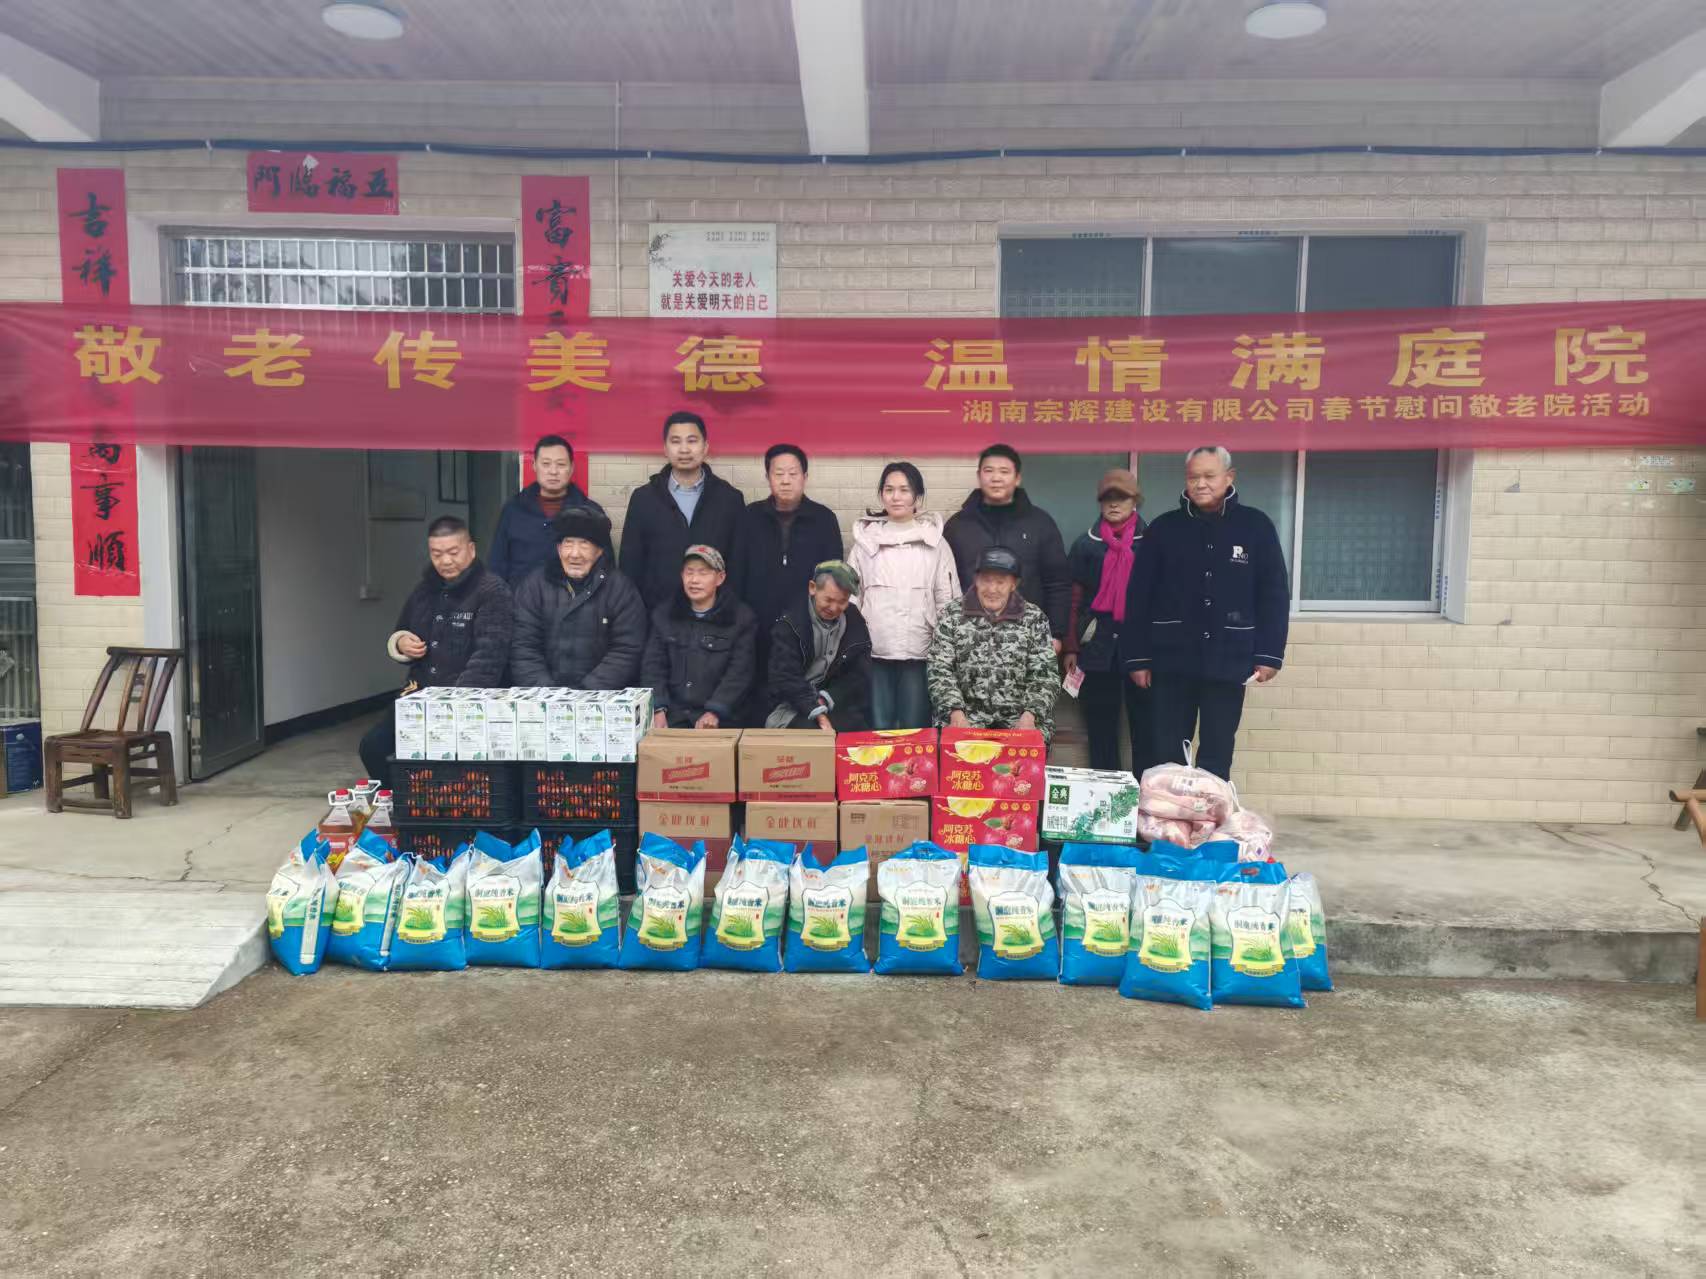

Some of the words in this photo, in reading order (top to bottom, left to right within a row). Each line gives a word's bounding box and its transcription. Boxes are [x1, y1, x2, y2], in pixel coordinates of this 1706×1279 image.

[672, 270, 756, 288] 关爱今天的老人
[661, 292, 768, 311] 就是关爱明天的自己
[73, 324, 766, 392] 敬老传美德
[924, 324, 1649, 392] 温情满庭院
[844, 771, 879, 784] 阿克苏
[946, 769, 982, 783] 阿克苏
[849, 780, 882, 793] 冰糖心
[951, 779, 985, 792] 冰糖心
[938, 823, 974, 836] 阿克苏
[943, 833, 977, 845] 冰糖心
